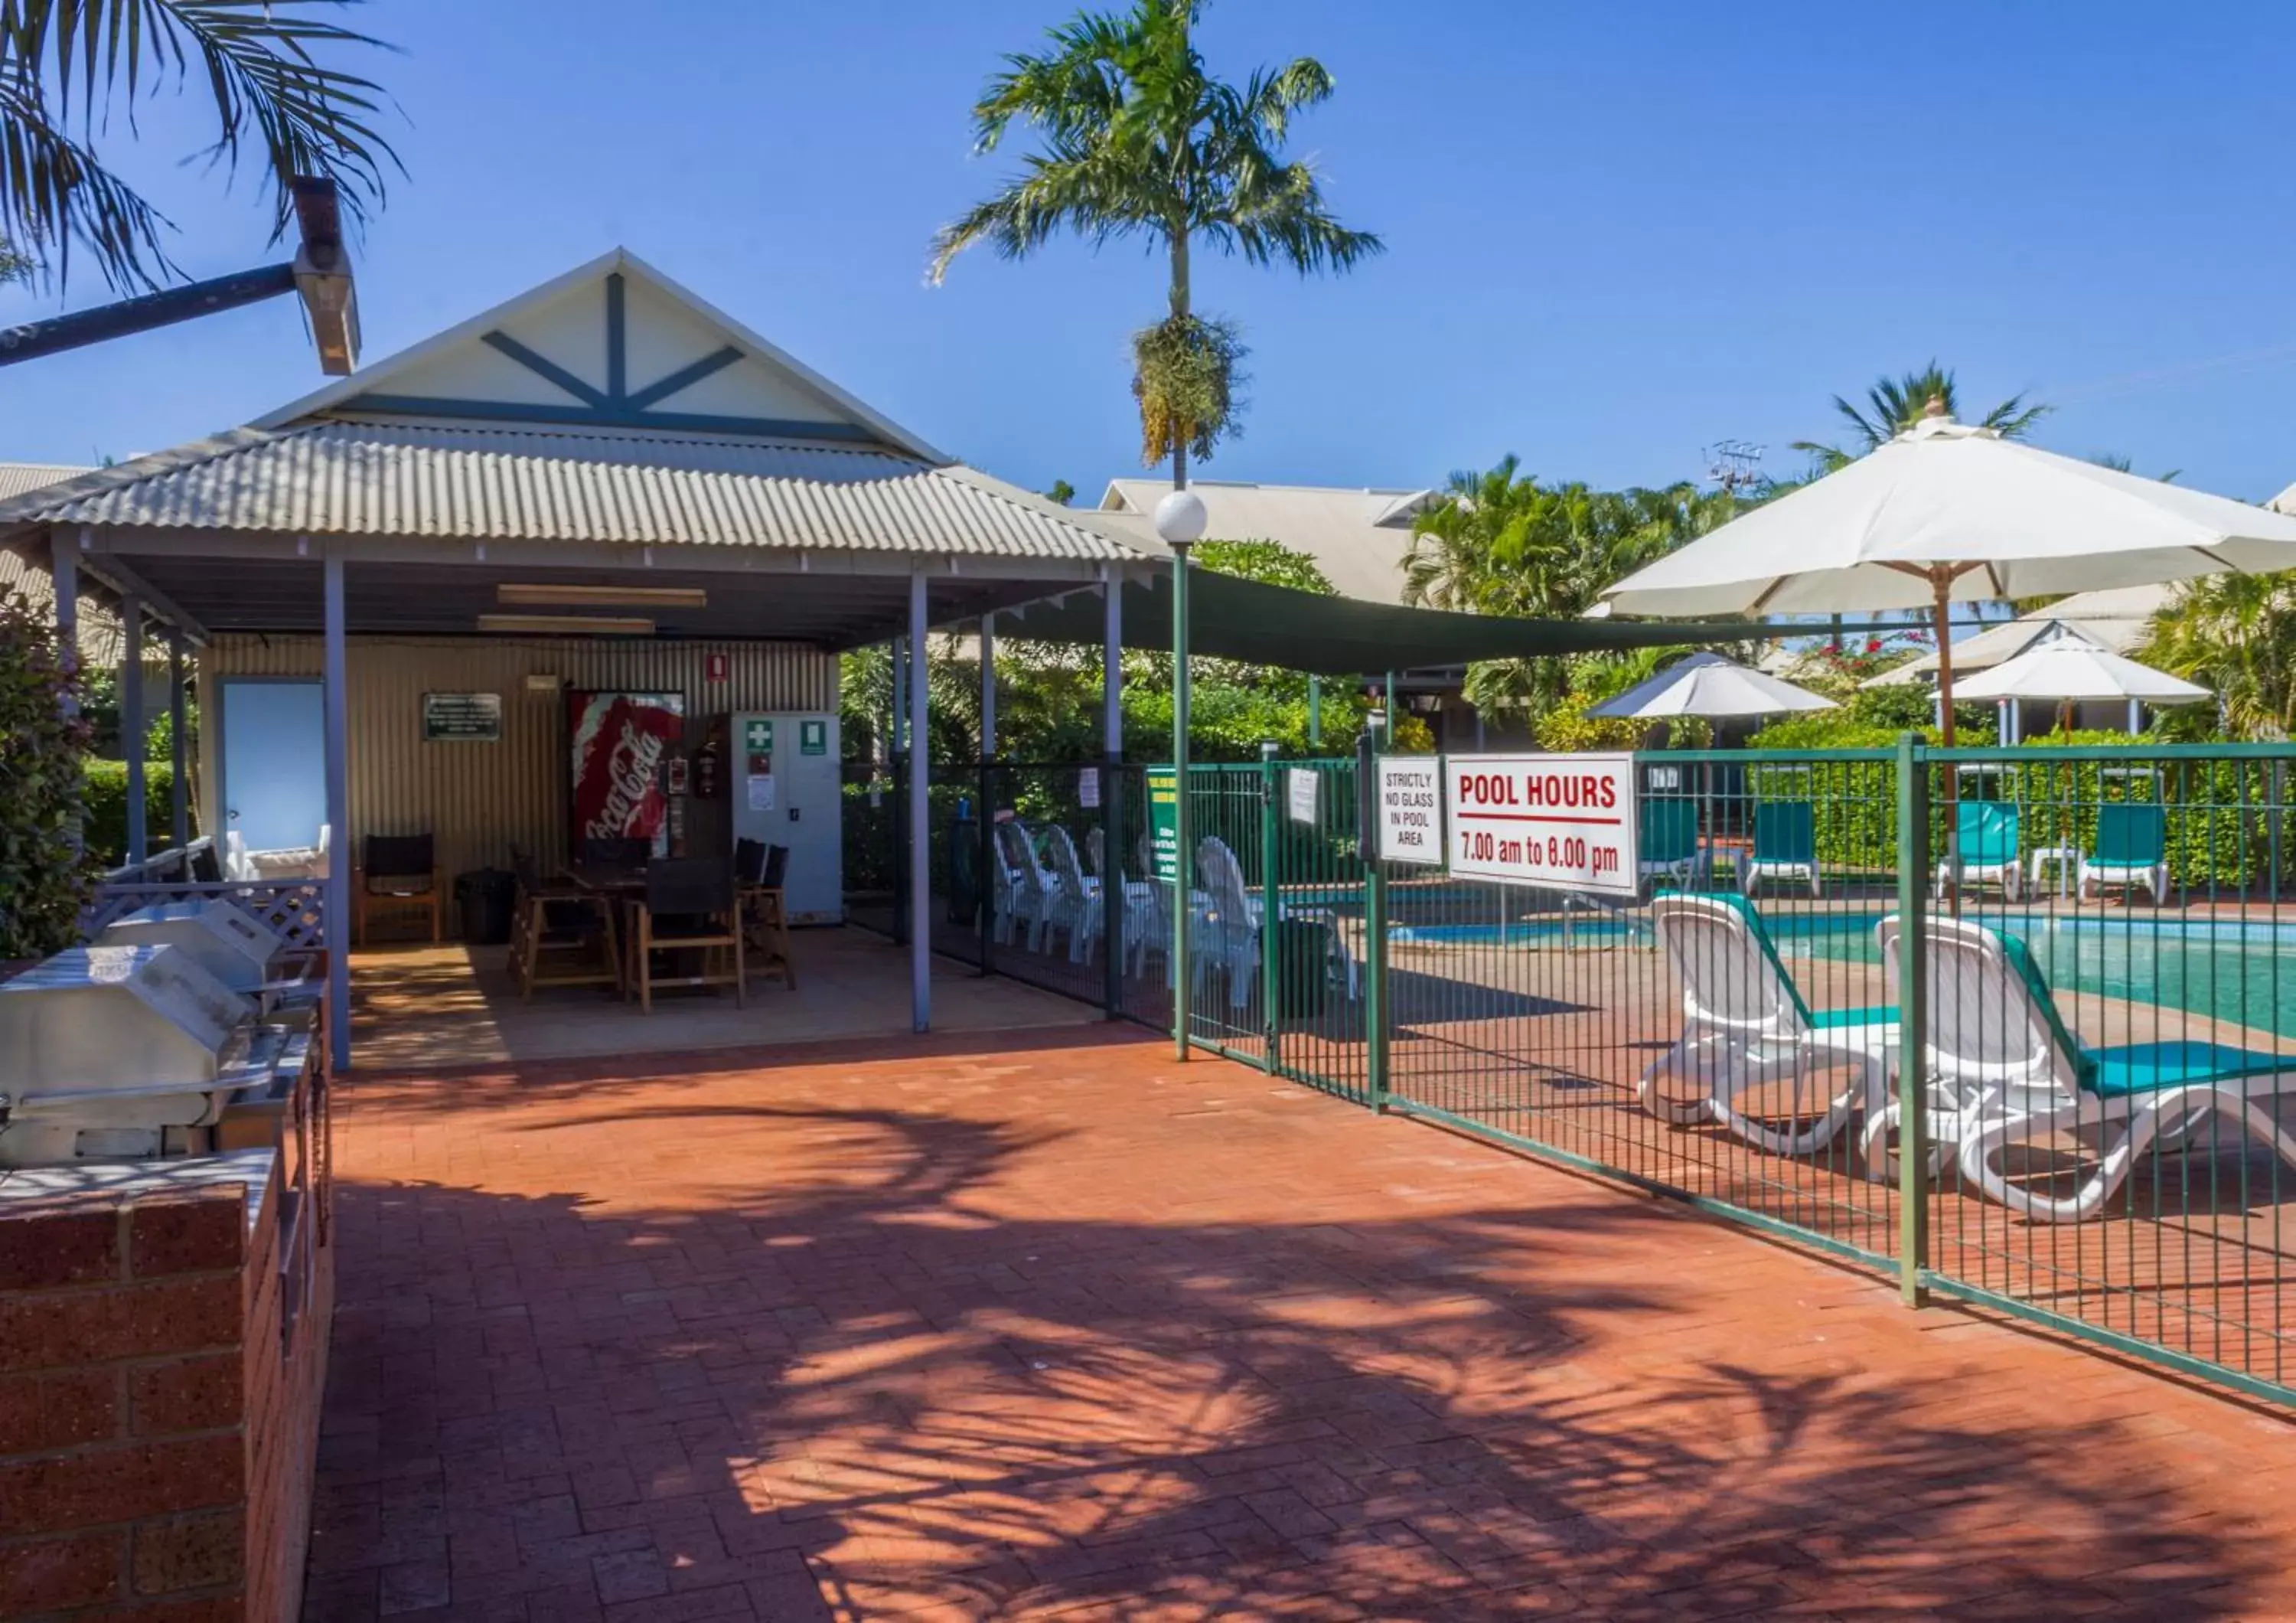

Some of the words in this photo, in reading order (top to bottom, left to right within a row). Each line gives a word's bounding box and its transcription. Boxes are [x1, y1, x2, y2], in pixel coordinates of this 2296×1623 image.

[1386, 772, 1432, 788] STRICTLY
[1459, 774, 1518, 805] POOL
[1527, 775, 1616, 808] HOURS
[1386, 792, 1400, 806] NO
[1401, 793, 1433, 808] GLASS
[1391, 812, 1400, 825] IN
[1403, 812, 1430, 828] POOL
[1397, 831, 1424, 846] AREA
[1461, 831, 1493, 861] 7.00
[1499, 839, 1521, 864] am
[1526, 836, 1542, 866] to
[1548, 835, 1586, 870] 8.00
[1592, 845, 1618, 877] pm
